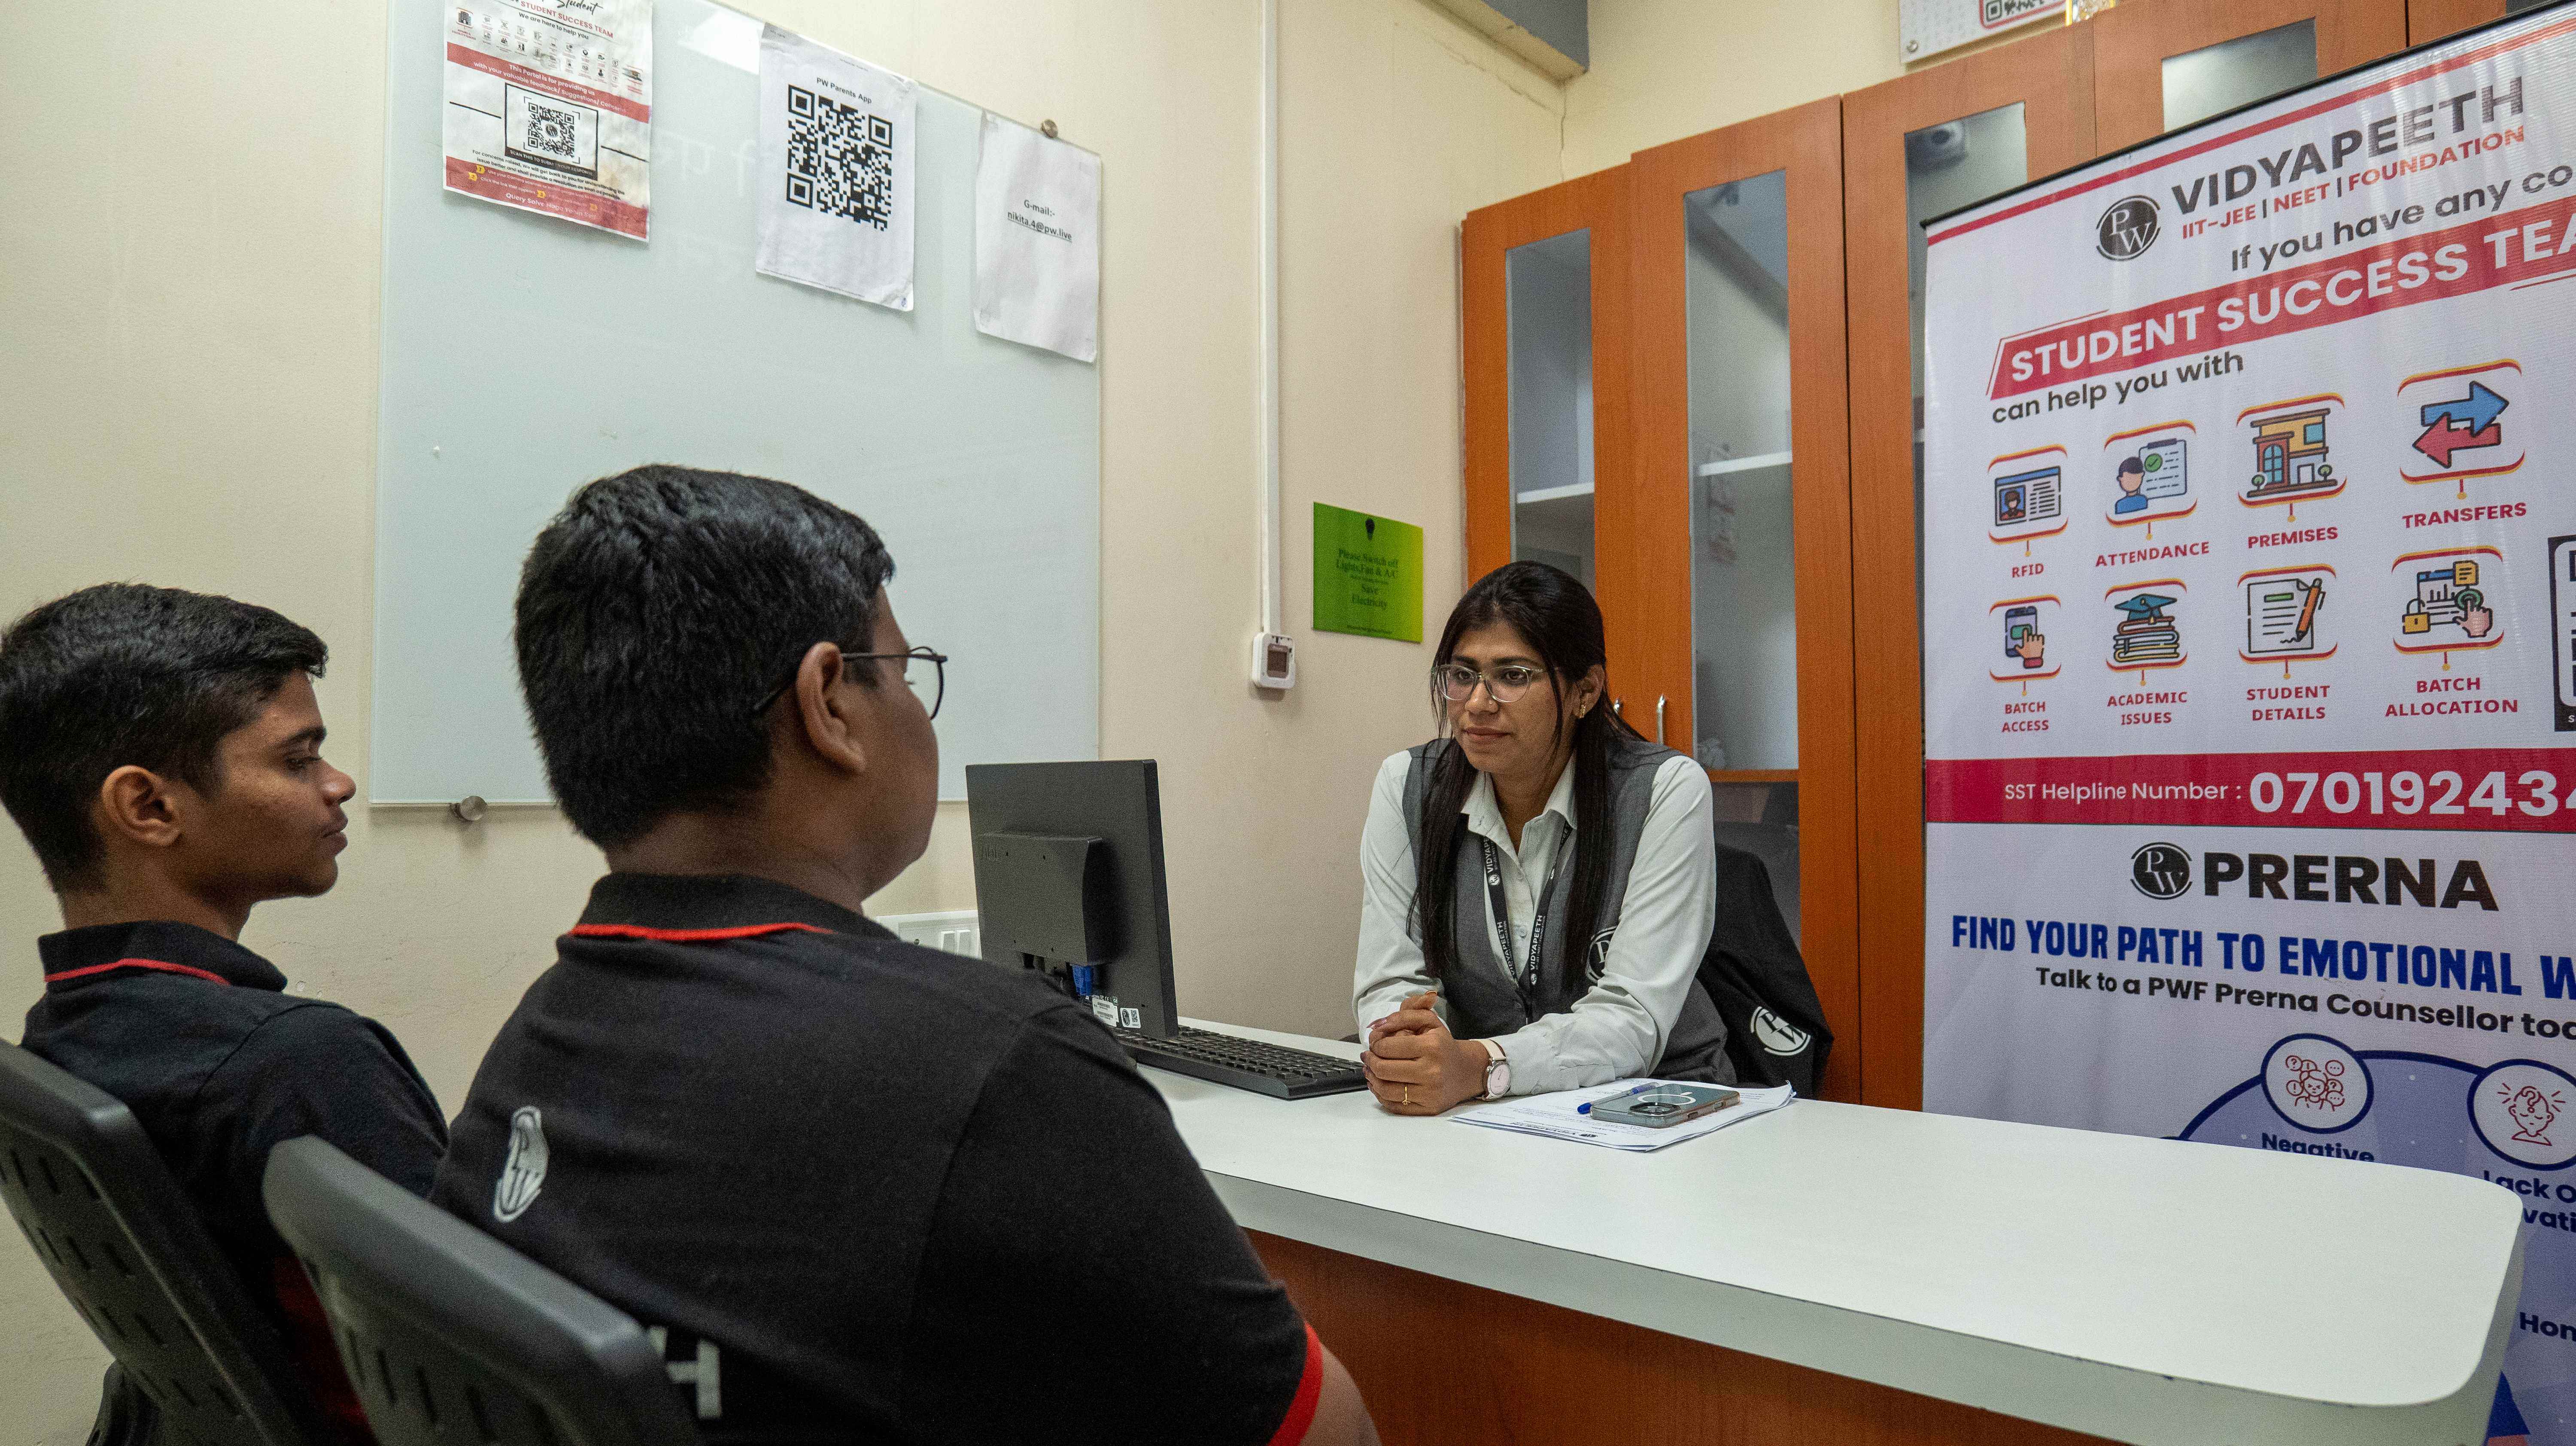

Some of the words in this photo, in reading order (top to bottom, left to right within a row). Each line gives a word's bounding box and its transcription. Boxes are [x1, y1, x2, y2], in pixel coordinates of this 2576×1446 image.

[521, 1, 556, 17] STUDENT
[558, 12, 592, 29] SUCCESS
[595, 24, 614, 38] TEAM
[542, 18, 556, 28] here
[563, 27, 576, 37] help
[488, 66, 502, 75] your
[503, 72, 529, 84] valuable
[509, 64, 522, 73] This
[522, 69, 541, 79] Portal
[548, 76, 557, 85] for
[558, 80, 588, 94] providing
[817, 77, 829, 87] PW
[830, 82, 856, 98] Parents
[858, 93, 872, 105] App
[2171, 76, 2524, 215] VIDYAPEETH
[482, 152, 504, 163] concerns
[585, 180, 617, 194] understanding
[491, 161, 506, 169] better
[529, 172, 549, 180] provide
[553, 178, 577, 189] resolution
[2182, 204, 2257, 240] IIT-JEE
[2273, 182, 2330, 213] NEET
[2348, 125, 2524, 192] FOUNDATION
[506, 193, 526, 203] Query
[527, 197, 544, 207] Solve
[1007, 211, 1072, 241] nikita.4@pw.live
[2232, 244, 2251, 271] If
[2259, 231, 2323, 272] you
[2334, 204, 2425, 246] have
[2435, 179, 2512, 217] any
[2011, 305, 2205, 381] STUDENT
[2217, 243, 2469, 332] SUCCESS
[1992, 399, 2040, 424] can
[2048, 383, 2108, 413] help
[2114, 369, 2168, 405] you
[2176, 351, 2244, 384] with
[2402, 501, 2527, 529] TRANSFERS
[2248, 526, 2339, 549] PREMISES
[2095, 541, 2210, 568] ATTENDANCE
[2012, 562, 2044, 578] RFID
[2107, 691, 2188, 707] ACADEMIC
[2246, 685, 2331, 701] STUDENT
[2416, 677, 2481, 693] BATCH
[2004, 701, 2046, 714] BATCH
[2120, 711, 2172, 726] ISSUES
[2252, 706, 2326, 721] DETAILS
[2385, 699, 2518, 717] ALLOCATION
[2001, 719, 2049, 732] ACCESS
[2005, 783, 2037, 800] SST
[2042, 782, 2126, 805] Helpline
[2132, 782, 2229, 800] Number
[2249, 770, 2576, 817] 07019243
[2204, 852, 2500, 911] PRERNA
[1497, 921, 1516, 976] VIDYAPEETH
[1530, 914, 1543, 970] VIDYAPEETH
[1953, 915, 2016, 951] FIND
[2026, 920, 2108, 960] YOUR
[2117, 926, 2203, 967] PATH
[2217, 932, 2266, 972] TO
[2279, 936, 2522, 996] EMOTIONAL
[2036, 966, 2093, 990] Talk
[2097, 972, 2118, 992] to
[2123, 977, 2141, 995] a
[2148, 977, 2208, 1001] PWF
[2215, 982, 2318, 1012] Prerna
[2326, 993, 2514, 1033] Counsellor
